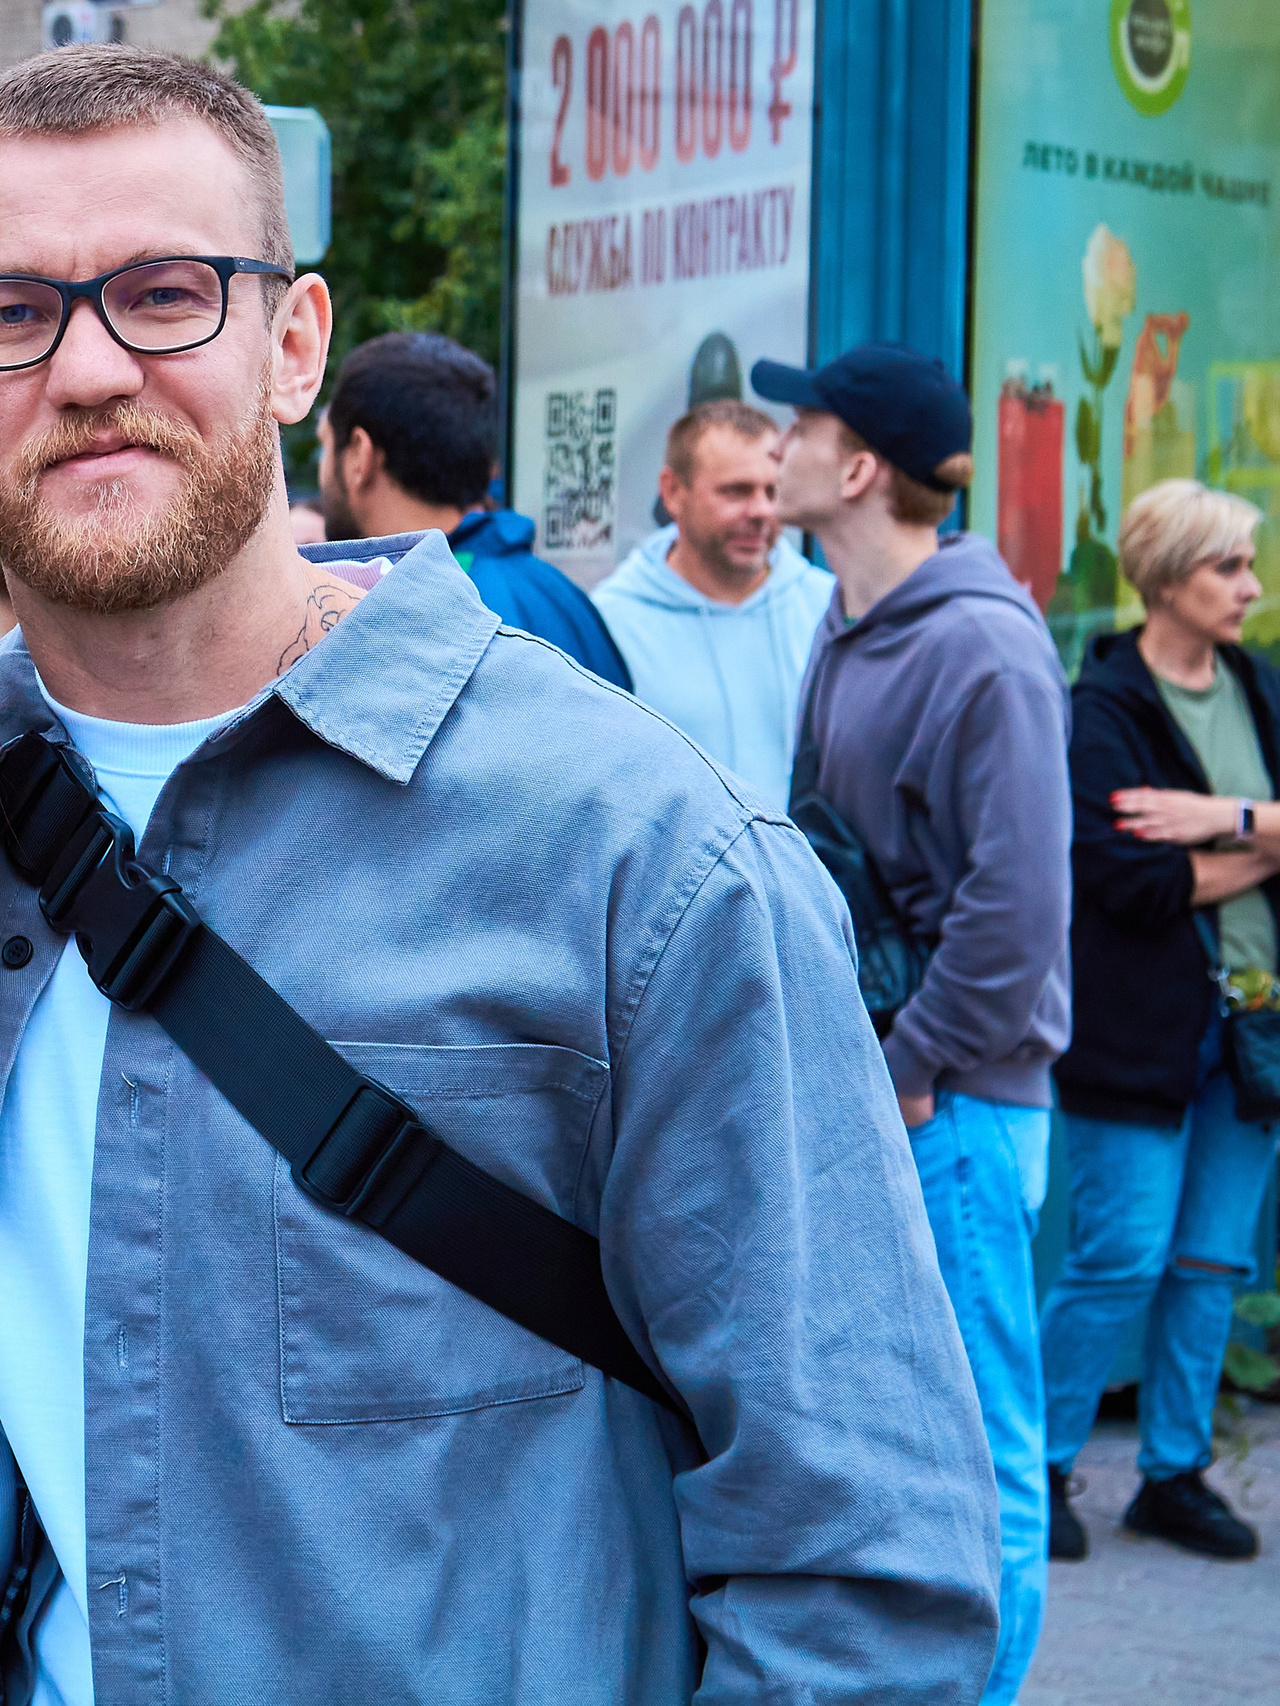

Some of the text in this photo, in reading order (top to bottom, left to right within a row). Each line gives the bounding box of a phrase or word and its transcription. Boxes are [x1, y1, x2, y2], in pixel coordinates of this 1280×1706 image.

[549, 34, 573, 188] 2
[585, 14, 661, 181] 000
[676, 0, 752, 164] 000
[1023, 139, 1079, 176] ЛЕТО
[1085, 151, 1099, 181] В
[1103, 155, 1195, 194] КАЖДОЙ
[546, 183, 795, 297] СЛУЖБА ПО КОНТРАКТУ
